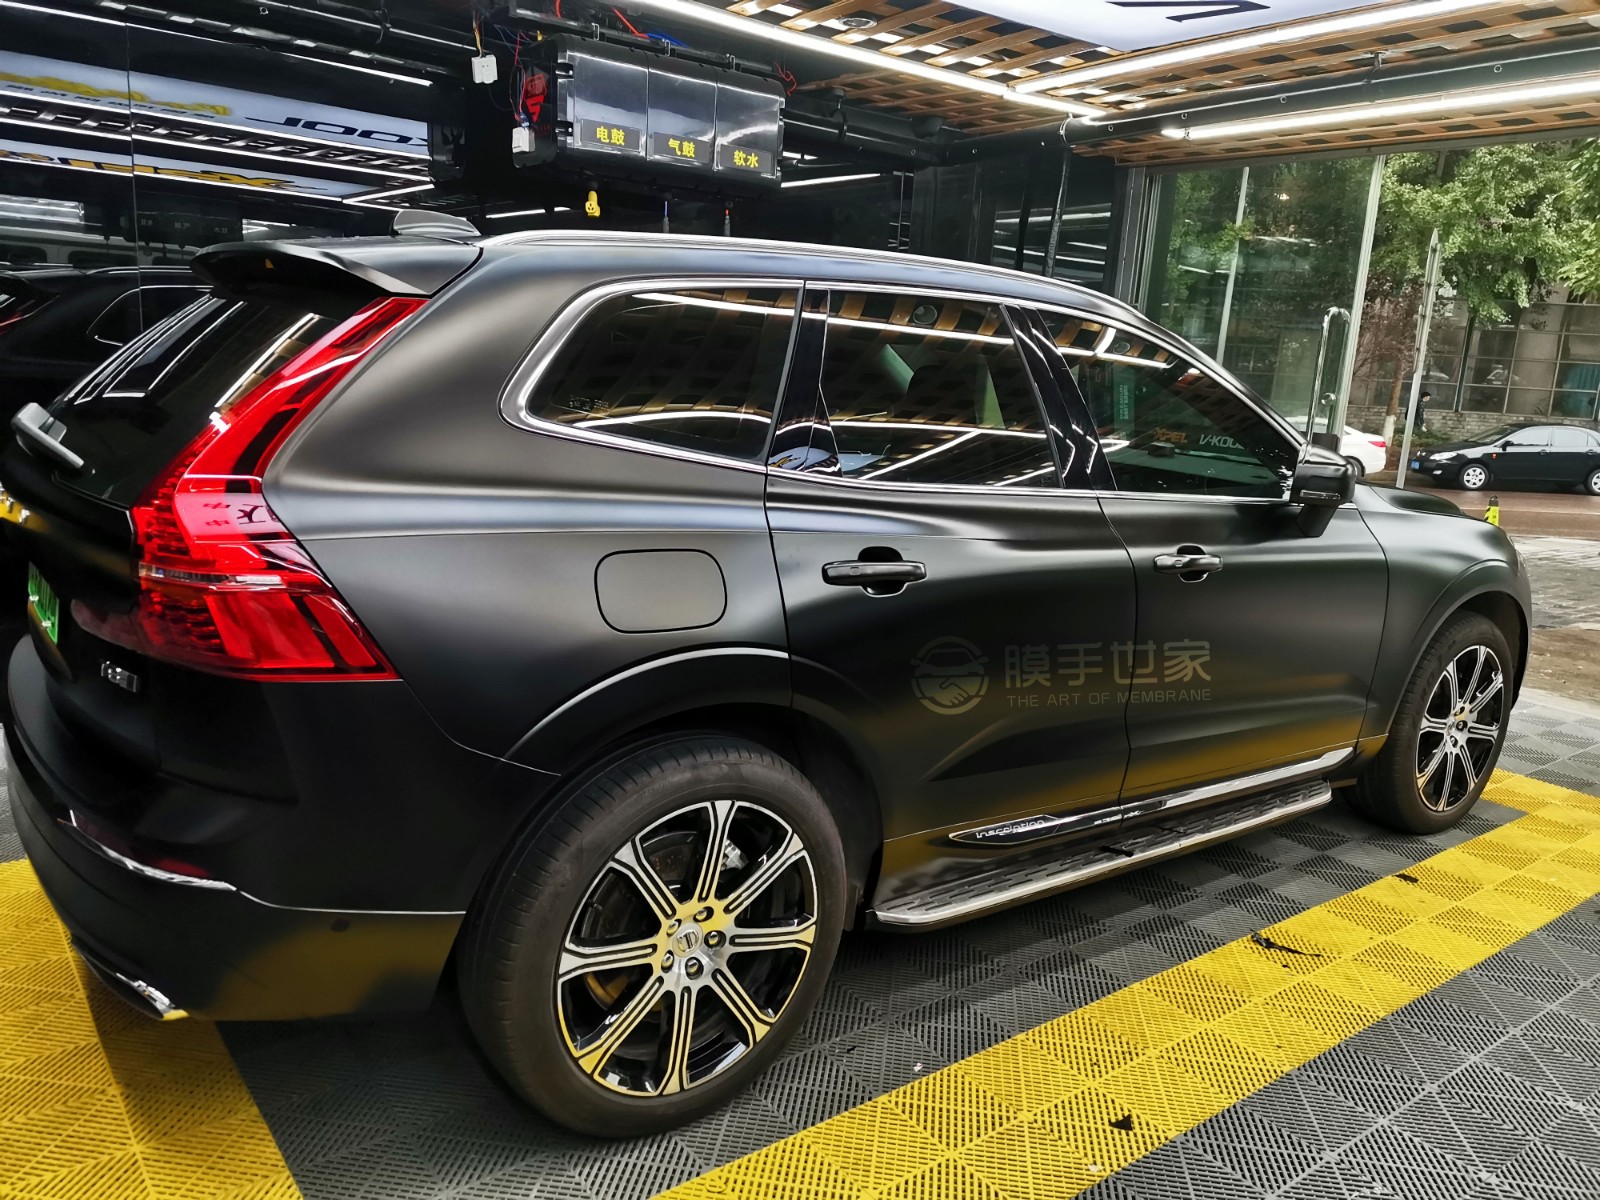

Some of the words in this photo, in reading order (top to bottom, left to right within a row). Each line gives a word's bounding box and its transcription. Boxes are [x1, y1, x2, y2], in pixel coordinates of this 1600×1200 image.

[596, 126, 625, 146] 电鼓
[668, 138, 695, 158] 气鼓
[734, 150, 759, 168] 软水
[1153, 427, 1188, 443] XPEL
[1199, 434, 1246, 450] V-KOO
